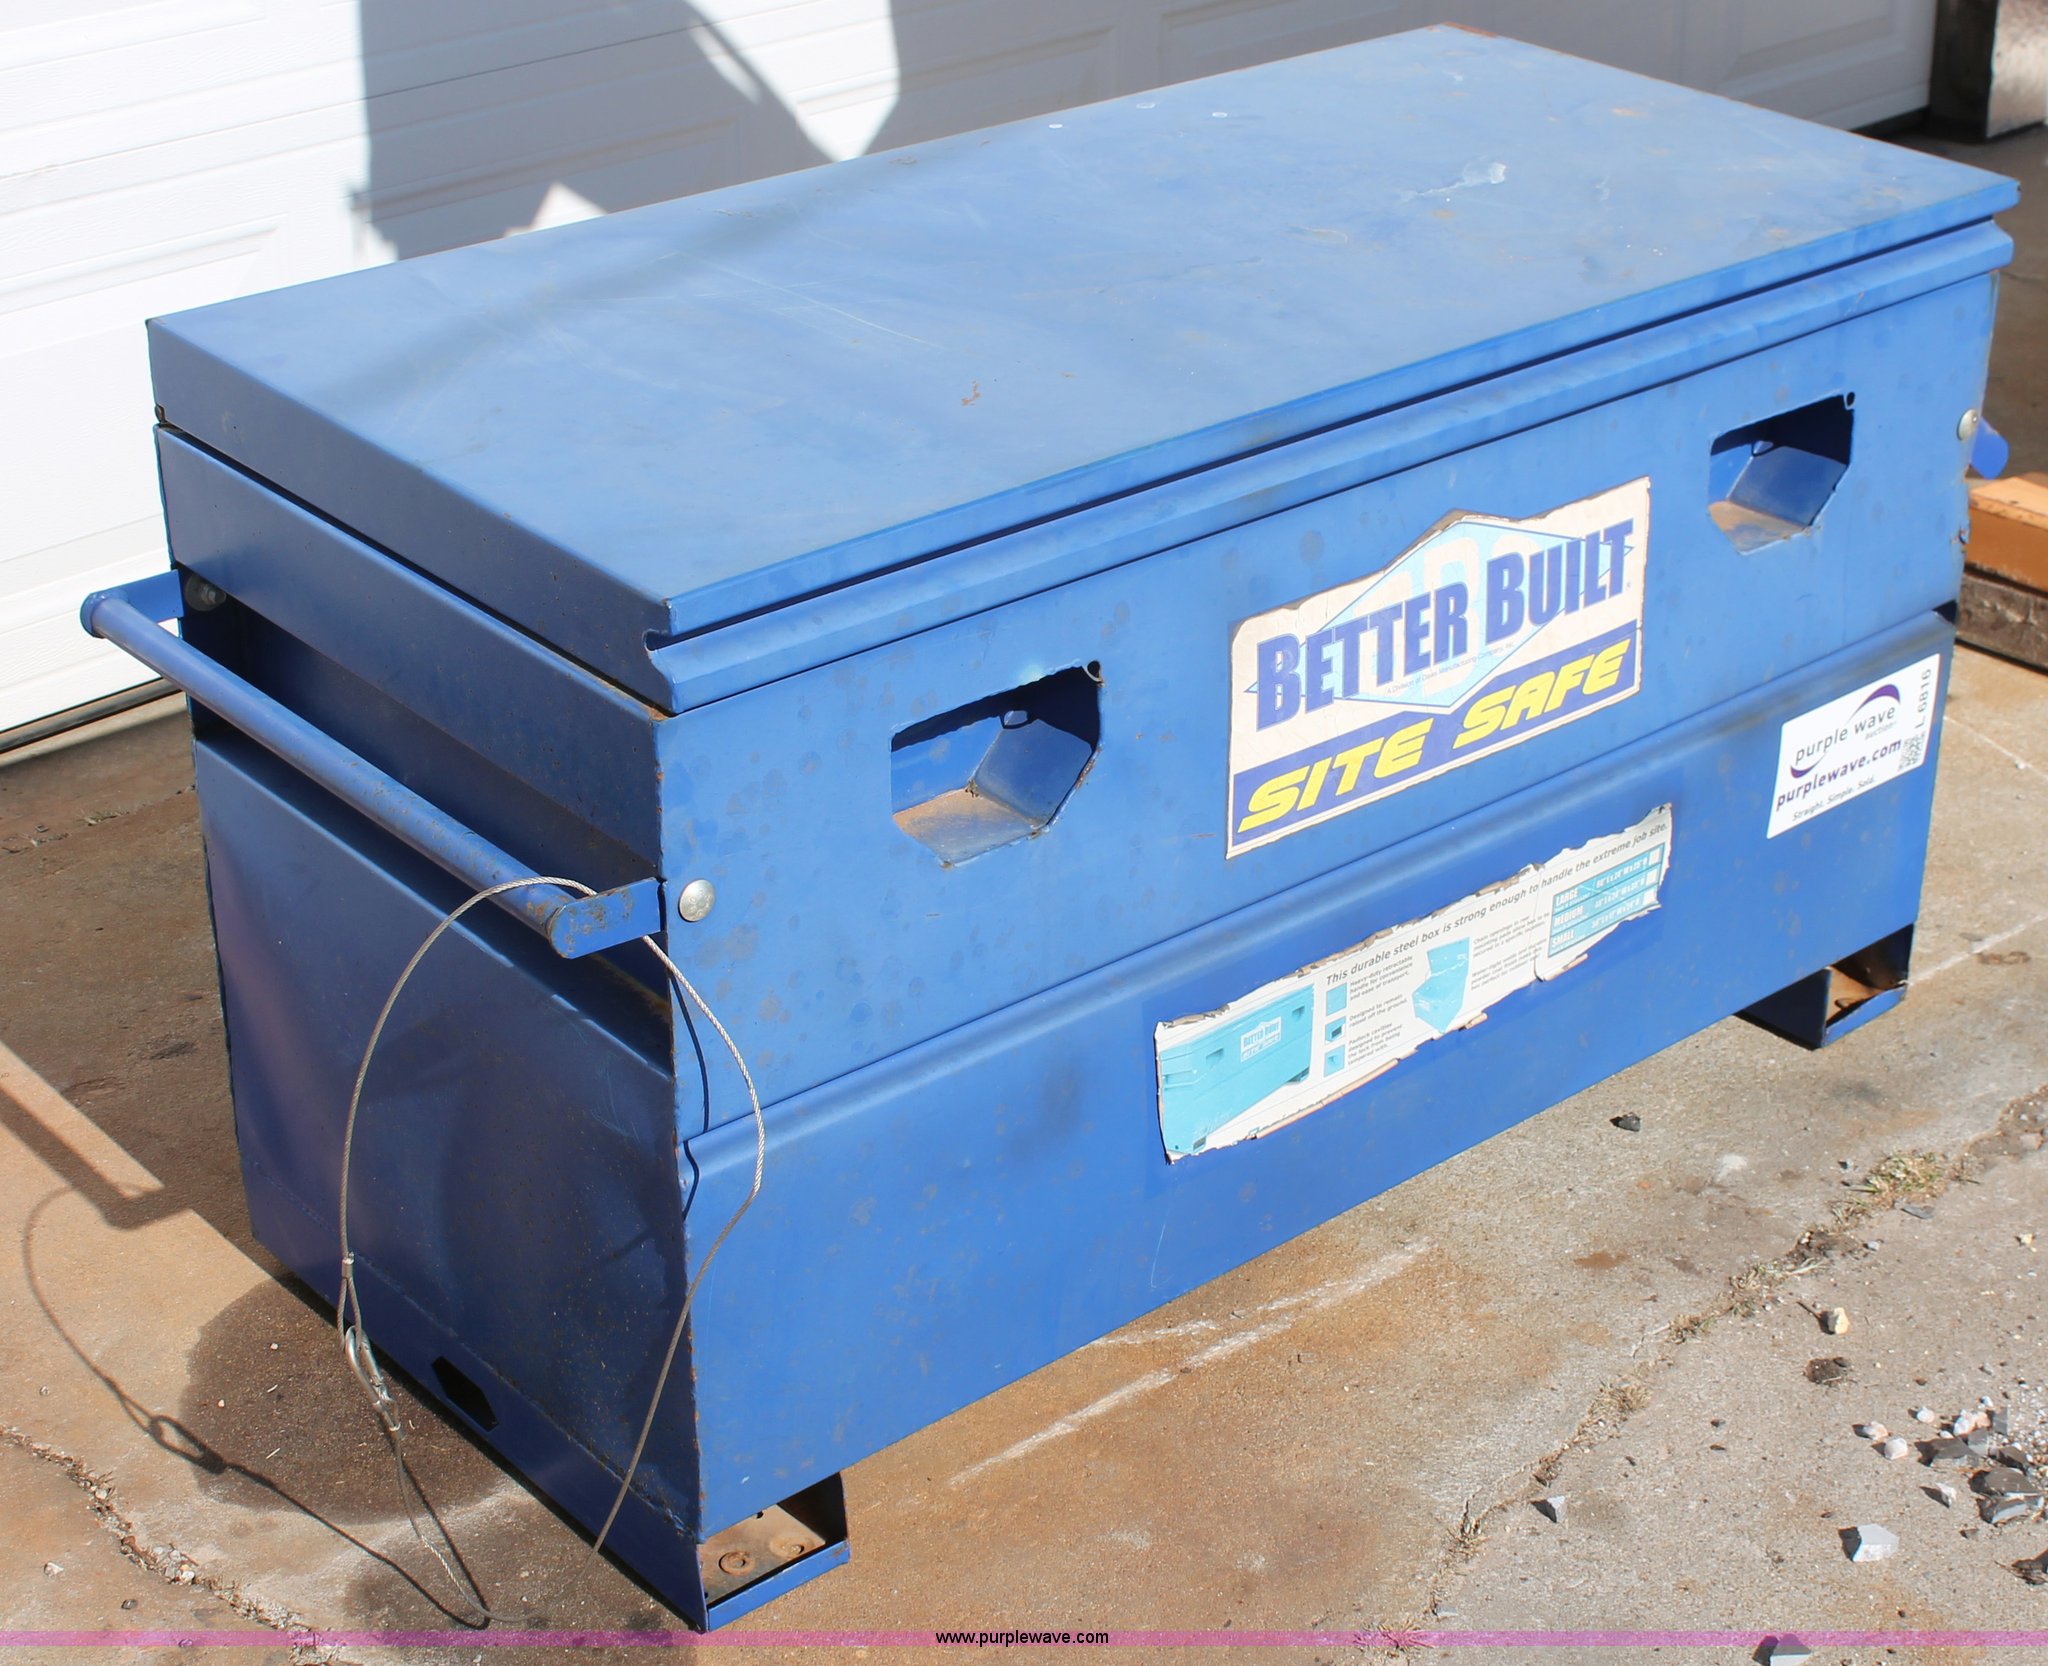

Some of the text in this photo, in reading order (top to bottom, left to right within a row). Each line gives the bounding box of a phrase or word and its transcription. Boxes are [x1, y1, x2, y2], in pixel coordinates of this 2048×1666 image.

[1256, 518, 1633, 732] BETTER BUILT
[1238, 639, 1630, 833] SITE SAFE
[1776, 739, 1901, 812] purplewave.com
[1795, 706, 1896, 766] purple wave
[1326, 823, 1668, 985] This durable steel box is strong enough to handle the extreme job site.
